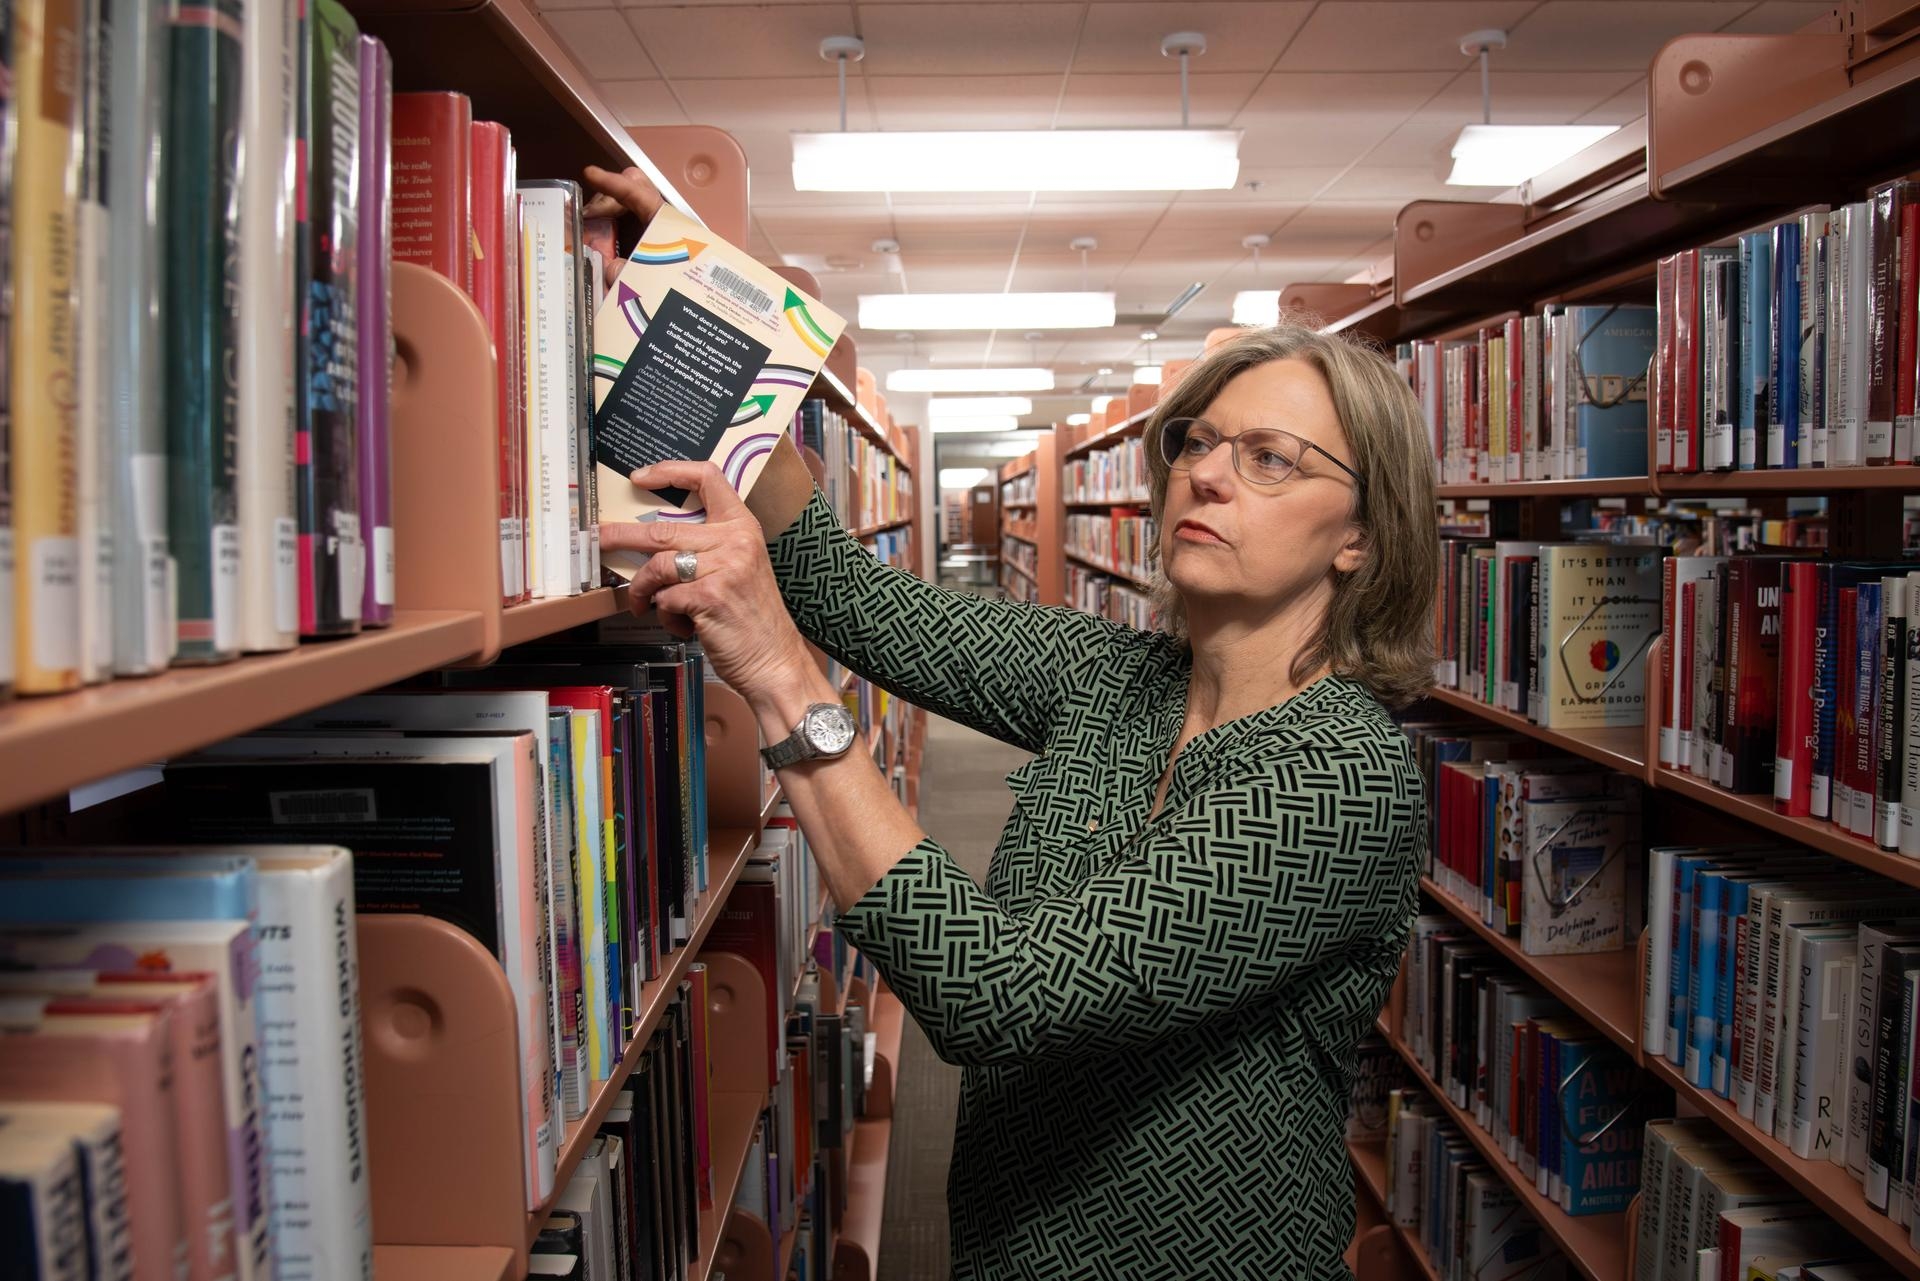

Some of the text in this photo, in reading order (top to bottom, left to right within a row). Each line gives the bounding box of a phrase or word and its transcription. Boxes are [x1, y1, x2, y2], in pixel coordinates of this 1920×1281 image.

[332, 50, 358, 228] NAUGHTY
[401, 190, 432, 198] research
[1876, 258, 1886, 290] THE
[681, 305, 699, 319] What
[698, 315, 713, 327] does
[717, 327, 735, 341] mean
[734, 337, 742, 345] to
[741, 342, 750, 350] be
[696, 324, 728, 345] ace or aro?
[1603, 327, 1652, 336] AMERICAN
[665, 328, 738, 375] challenges that come with
[668, 321, 684, 333] How
[682, 329, 703, 345] should
[704, 344, 732, 364] approach
[731, 359, 743, 369] the
[673, 343, 721, 374] being ace or aro?
[648, 342, 663, 354] How
[662, 350, 674, 361] can
[676, 359, 690, 370] best
[689, 368, 712, 385] support
[712, 381, 724, 391] the
[722, 387, 734, 397] ace
[652, 353, 722, 399] and aro people in my life?
[1873, 354, 1883, 386] AGE
[1562, 557, 1650, 567] IT'S BETTER
[1586, 577, 1625, 586] THAN
[1572, 596, 1584, 605] IT
[1886, 624, 1895, 640] FOX
[1728, 602, 1738, 726] UNDERSTANDING ANGRY GROUPS
[1860, 650, 1870, 672] BLUE
[1886, 656, 1894, 671] THE
[1561, 695, 1646, 705] EASTERBROO
[1812, 627, 1825, 759] Political Rumors
[1885, 673, 1893, 701] TRUTH
[1858, 718, 1868, 734] RED
[1884, 704, 1892, 720] HAS
[1884, 723, 1892, 760] CHANGED
[1907, 666, 1920, 791] Affairs of Honor
[1858, 741, 1868, 770] STATES
[1750, 896, 1762, 918] THE
[1769, 906, 1781, 928] THE
[1547, 918, 1595, 942] Delphine
[1577, 924, 1618, 945] Minoui
[1747, 920, 1760, 985] POLITICIANS
[1766, 932, 1780, 997] POLITICIANS
[1858, 943, 1874, 1048] VALUE(S)
[1901, 984, 1911, 1032] THRIVING
[1744, 1002, 1756, 1021] THE
[1764, 1014, 1774, 1034] THE
[1881, 1015, 1892, 1038] The
[332, 899, 362, 1184] WICKED THOUGHTS
[1742, 1024, 1754, 1082] EGALITARI
[1759, 1038, 1773, 1094] EGALITARI
[1875, 1046, 1890, 1114] Education
[1859, 1100, 1869, 1129] MAR
[1895, 1080, 1905, 1134] ECONOMY
[1872, 1120, 1884, 1151] Trap
[1581, 1159, 1638, 1190] AMER
[1581, 1193, 1622, 1206] ANDREW
[1650, 1159, 1663, 1235] THE AGE OF
[1679, 1185, 1691, 1264] THE AGE OF
